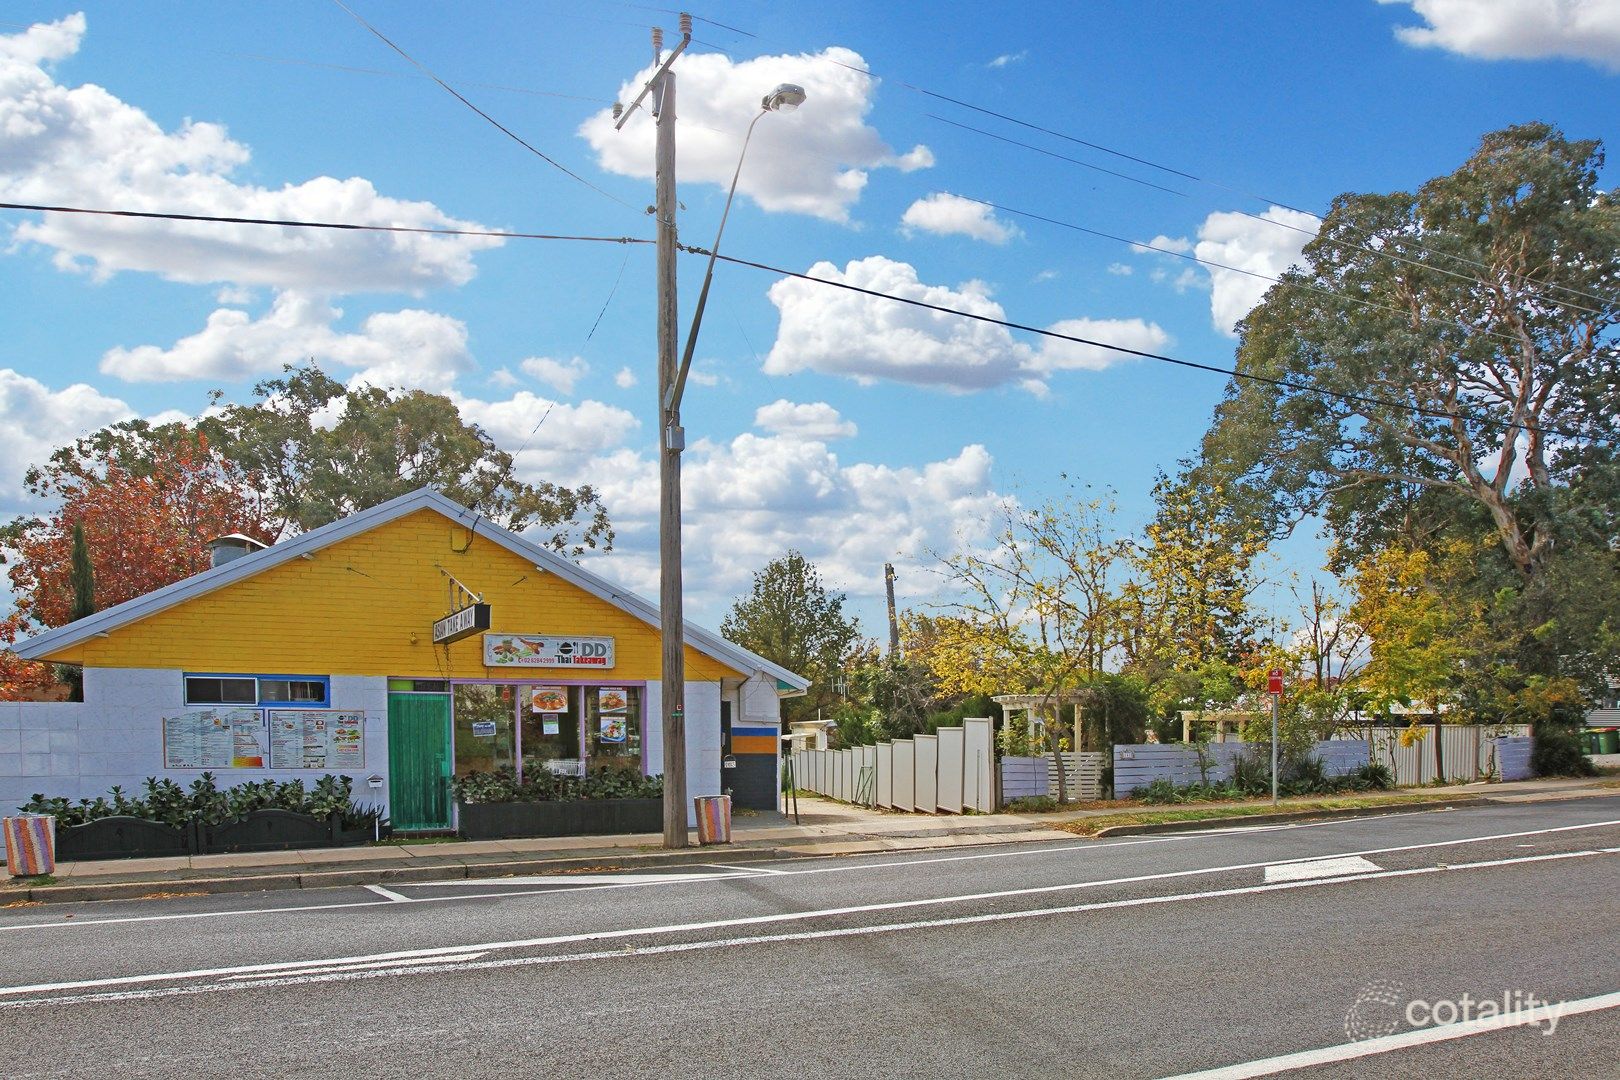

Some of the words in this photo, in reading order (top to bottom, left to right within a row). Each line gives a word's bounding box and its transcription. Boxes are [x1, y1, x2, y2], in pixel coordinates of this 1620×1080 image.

[447, 614, 459, 635] TAKE
[459, 607, 473, 631] AWAY
[581, 642, 607, 657] DD
[554, 654, 572, 664] Thai
[572, 654, 607, 665] Takeaway
